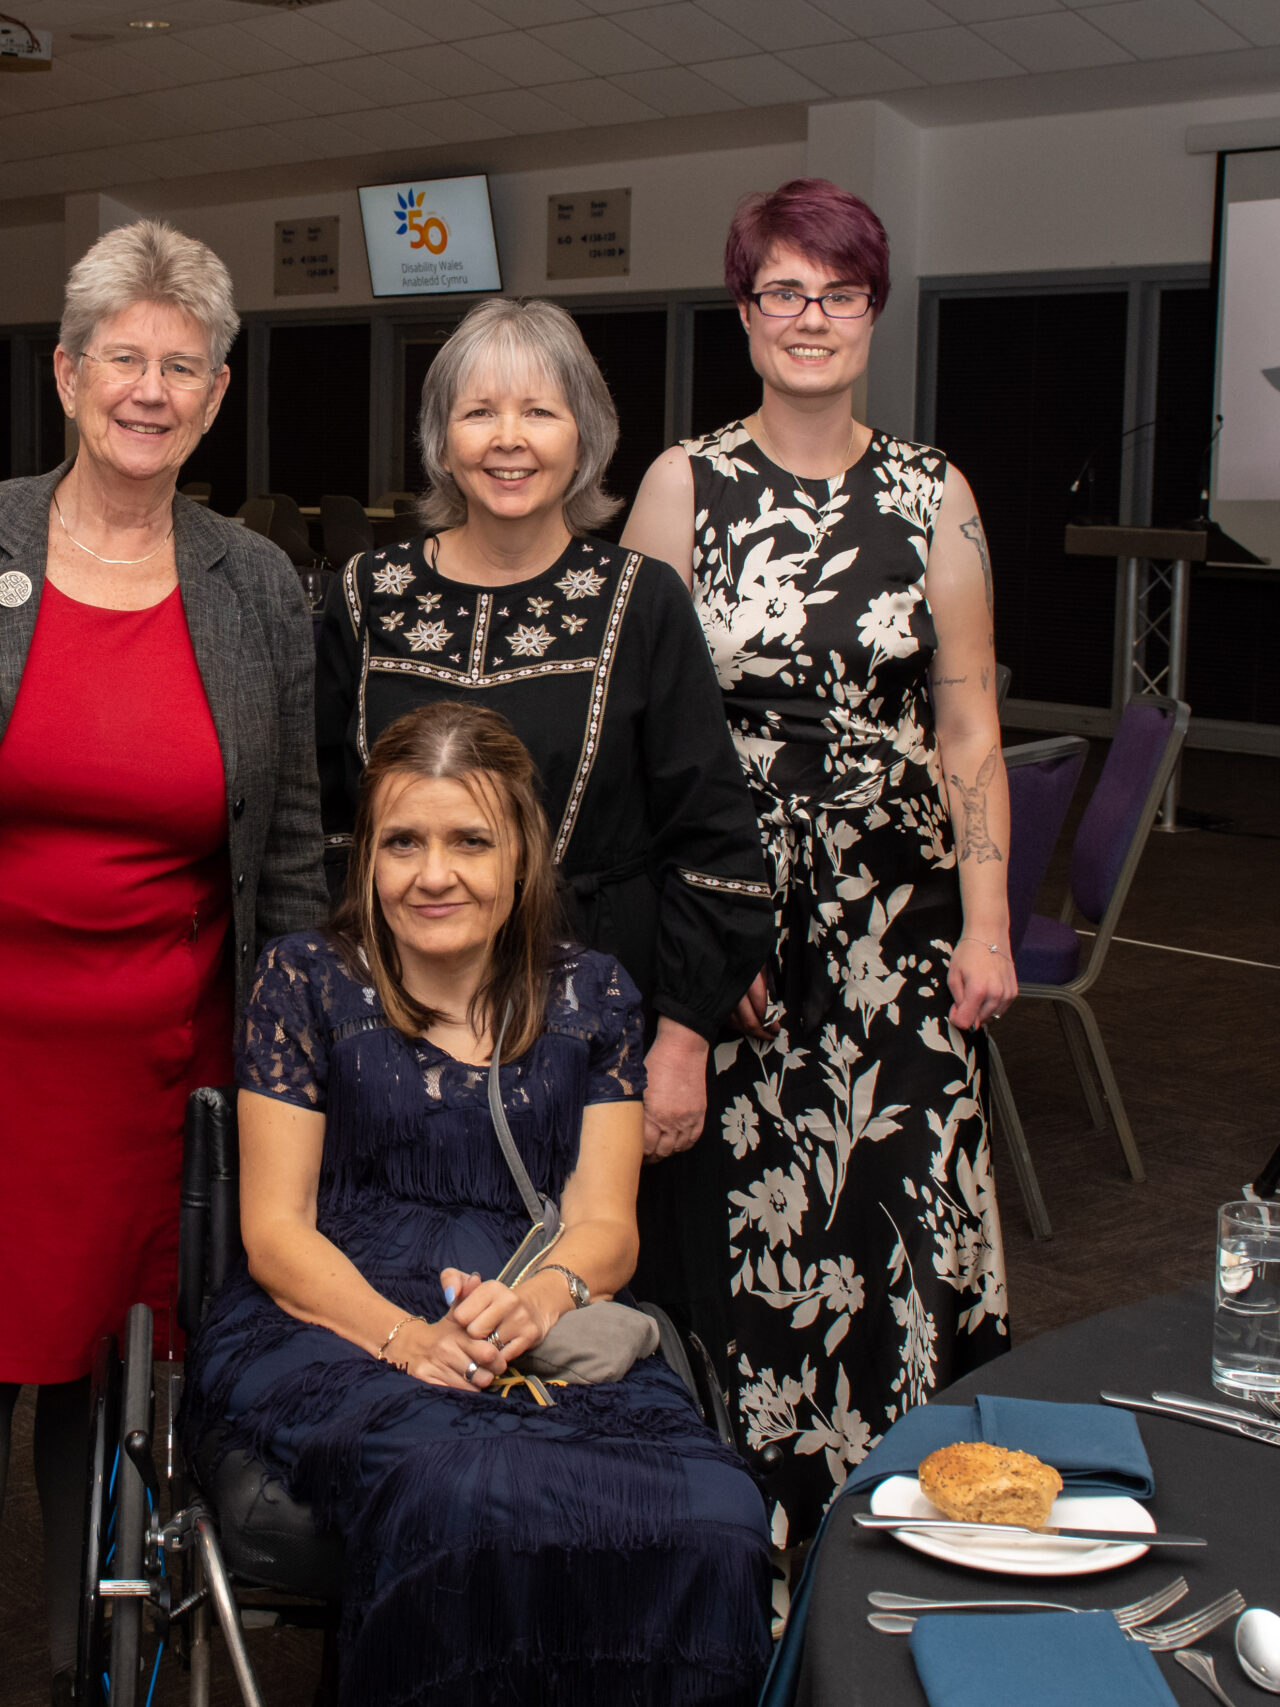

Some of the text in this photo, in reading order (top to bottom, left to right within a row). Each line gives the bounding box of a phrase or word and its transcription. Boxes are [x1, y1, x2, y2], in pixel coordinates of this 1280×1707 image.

[408, 209, 448, 255] 50
[401, 260, 463, 274] Disability Wales
[402, 274, 468, 288] Anabledd Cymru
